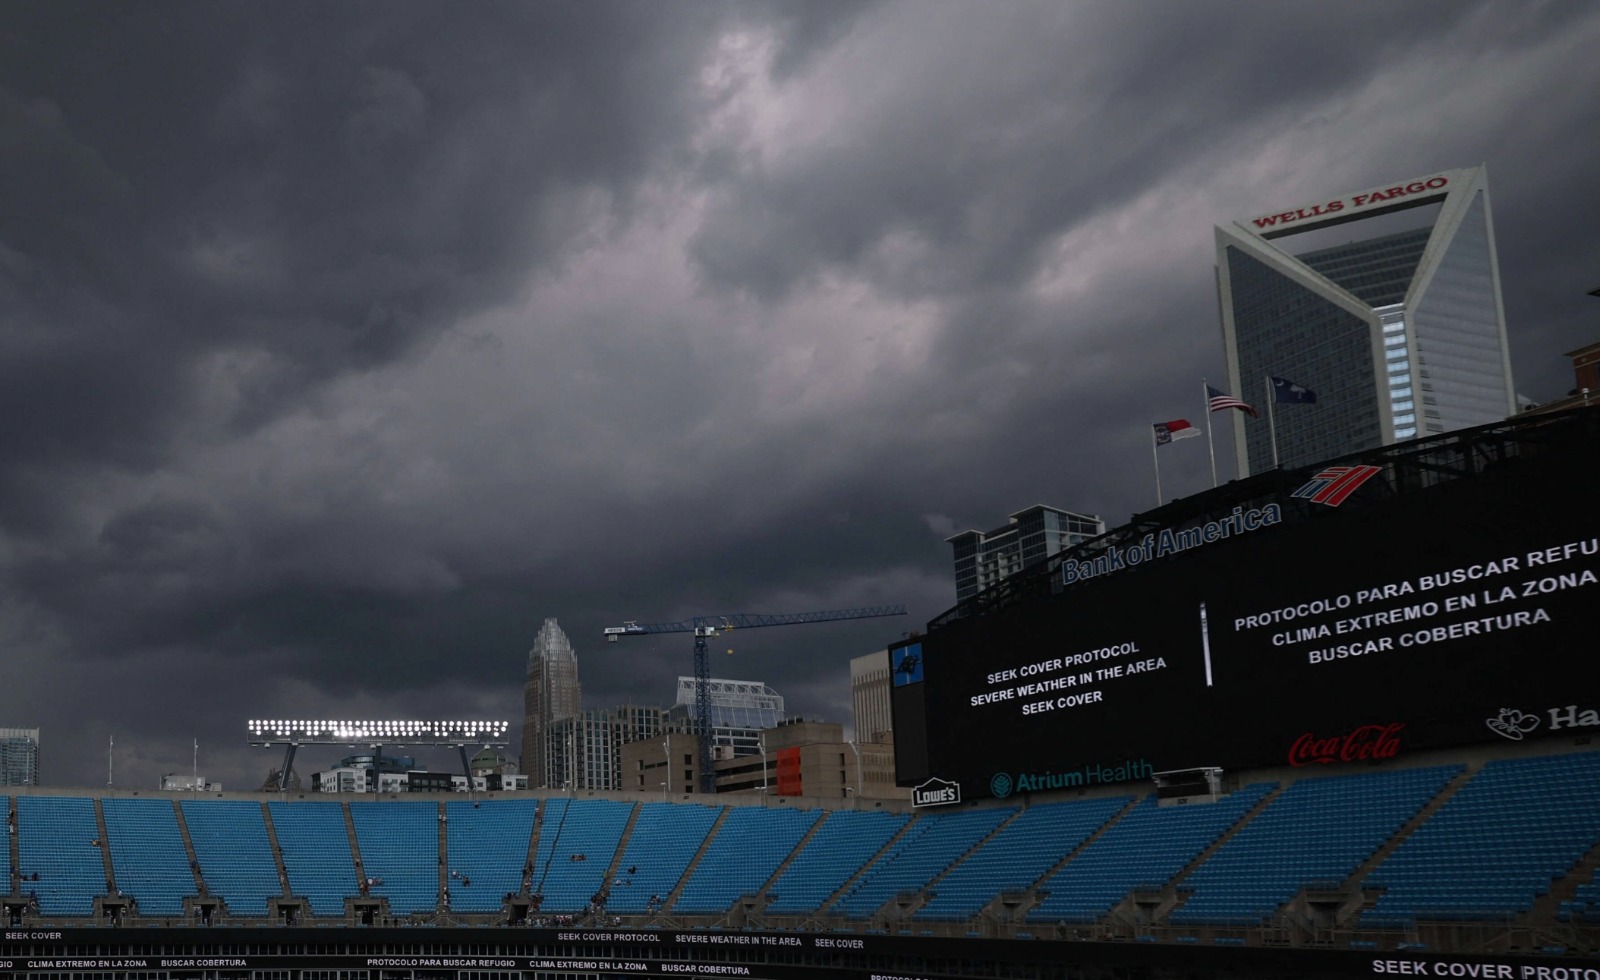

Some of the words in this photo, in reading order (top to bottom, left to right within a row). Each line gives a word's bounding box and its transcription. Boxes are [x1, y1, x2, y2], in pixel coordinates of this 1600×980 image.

[1252, 200, 1345, 229] WELLS
[1352, 177, 1449, 207] FARGO
[1062, 545, 1125, 585] Bank
[1125, 534, 1155, 566] of
[1156, 503, 1282, 558] America
[1235, 594, 1350, 631] PROTOCOLO
[1357, 581, 1414, 604] PARA
[1419, 556, 1519, 590] BUSCAR
[1527, 538, 1597, 567] REFU
[1272, 624, 1331, 645] CLIMA
[1336, 601, 1438, 634] EXTREMO
[1445, 593, 1476, 612] EN
[1484, 586, 1516, 604] LA
[1522, 570, 1597, 596] ZONA
[1309, 637, 1393, 663] BUSCAR
[1399, 608, 1550, 646] COBERTURA
[987, 668, 1017, 684] SEEK
[1020, 658, 1062, 676] COVER
[1065, 642, 1139, 667] PROTOCOL
[970, 688, 1014, 706] SEVERE
[1016, 675, 1076, 696] WEATHER
[1079, 672, 1092, 684] IN
[1095, 665, 1122, 680] THE
[1126, 657, 1166, 675] AREA
[1022, 699, 1054, 715] SEEK
[1057, 690, 1102, 708] COVER
[1288, 722, 1408, 768] Coca-Cola
[1016, 770, 1083, 793] Atrium
[1085, 759, 1154, 785] Health
[916, 786, 955, 804] LOWE'S
[557, 932, 580, 940] SEEK
[613, 933, 660, 941] PROTOCOL
[675, 934, 708, 943] SEVERE
[709, 935, 749, 944] WEATHER
[751, 936, 759, 944] IN
[761, 936, 776, 945] THE
[778, 937, 801, 945] AREA
[815, 938, 835, 947] SEEK
[836, 939, 863, 948] COVER
[599, 961, 610, 969] EN
[624, 962, 647, 970] ZONA
[661, 963, 696, 972] BUSCAR
[698, 965, 749, 974] COBERTURA
[1373, 959, 1428, 975] SEEK
[1434, 962, 1513, 979] COVER
